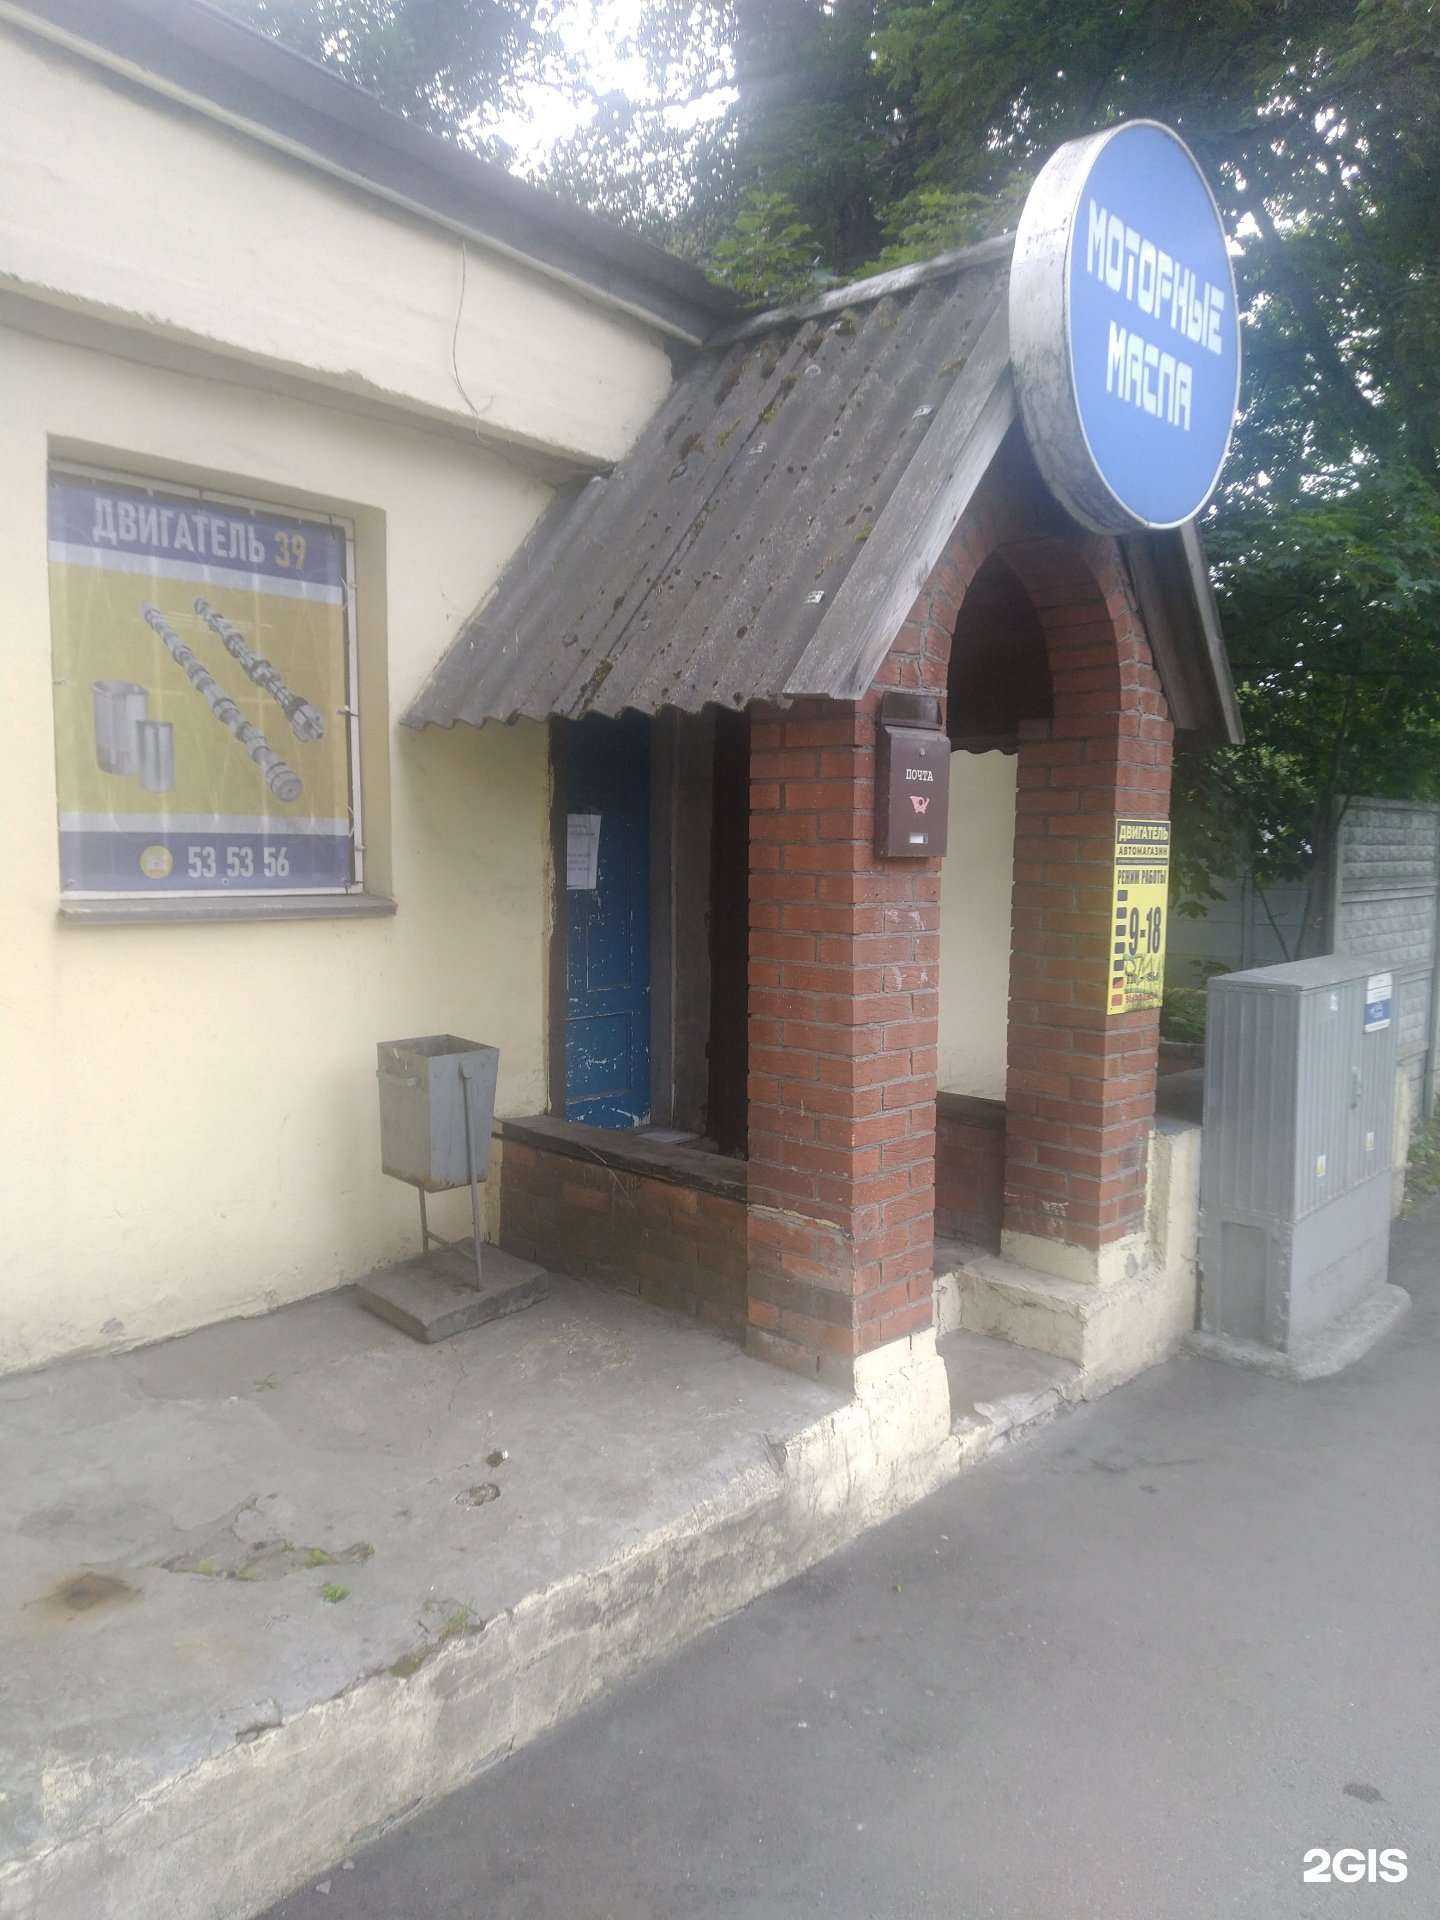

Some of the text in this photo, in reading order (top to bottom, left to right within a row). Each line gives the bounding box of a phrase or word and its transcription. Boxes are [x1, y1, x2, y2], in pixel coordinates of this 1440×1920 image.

[1086, 198, 1225, 355] МОТОРНЫЕ
[1106, 319, 1194, 432] МАСЛА
[92, 496, 307, 571] ДВИГАТЕЛЬ 39
[905, 767, 934, 782] ПОЧТА
[1118, 825, 1169, 842] ДВИГАТЕЛЬ
[188, 846, 290, 878] 53 53 56
[1118, 846, 1168, 857] АВТОМАГАЗИН
[1117, 869, 1167, 885] РЕЖИМ РАБОТЫ
